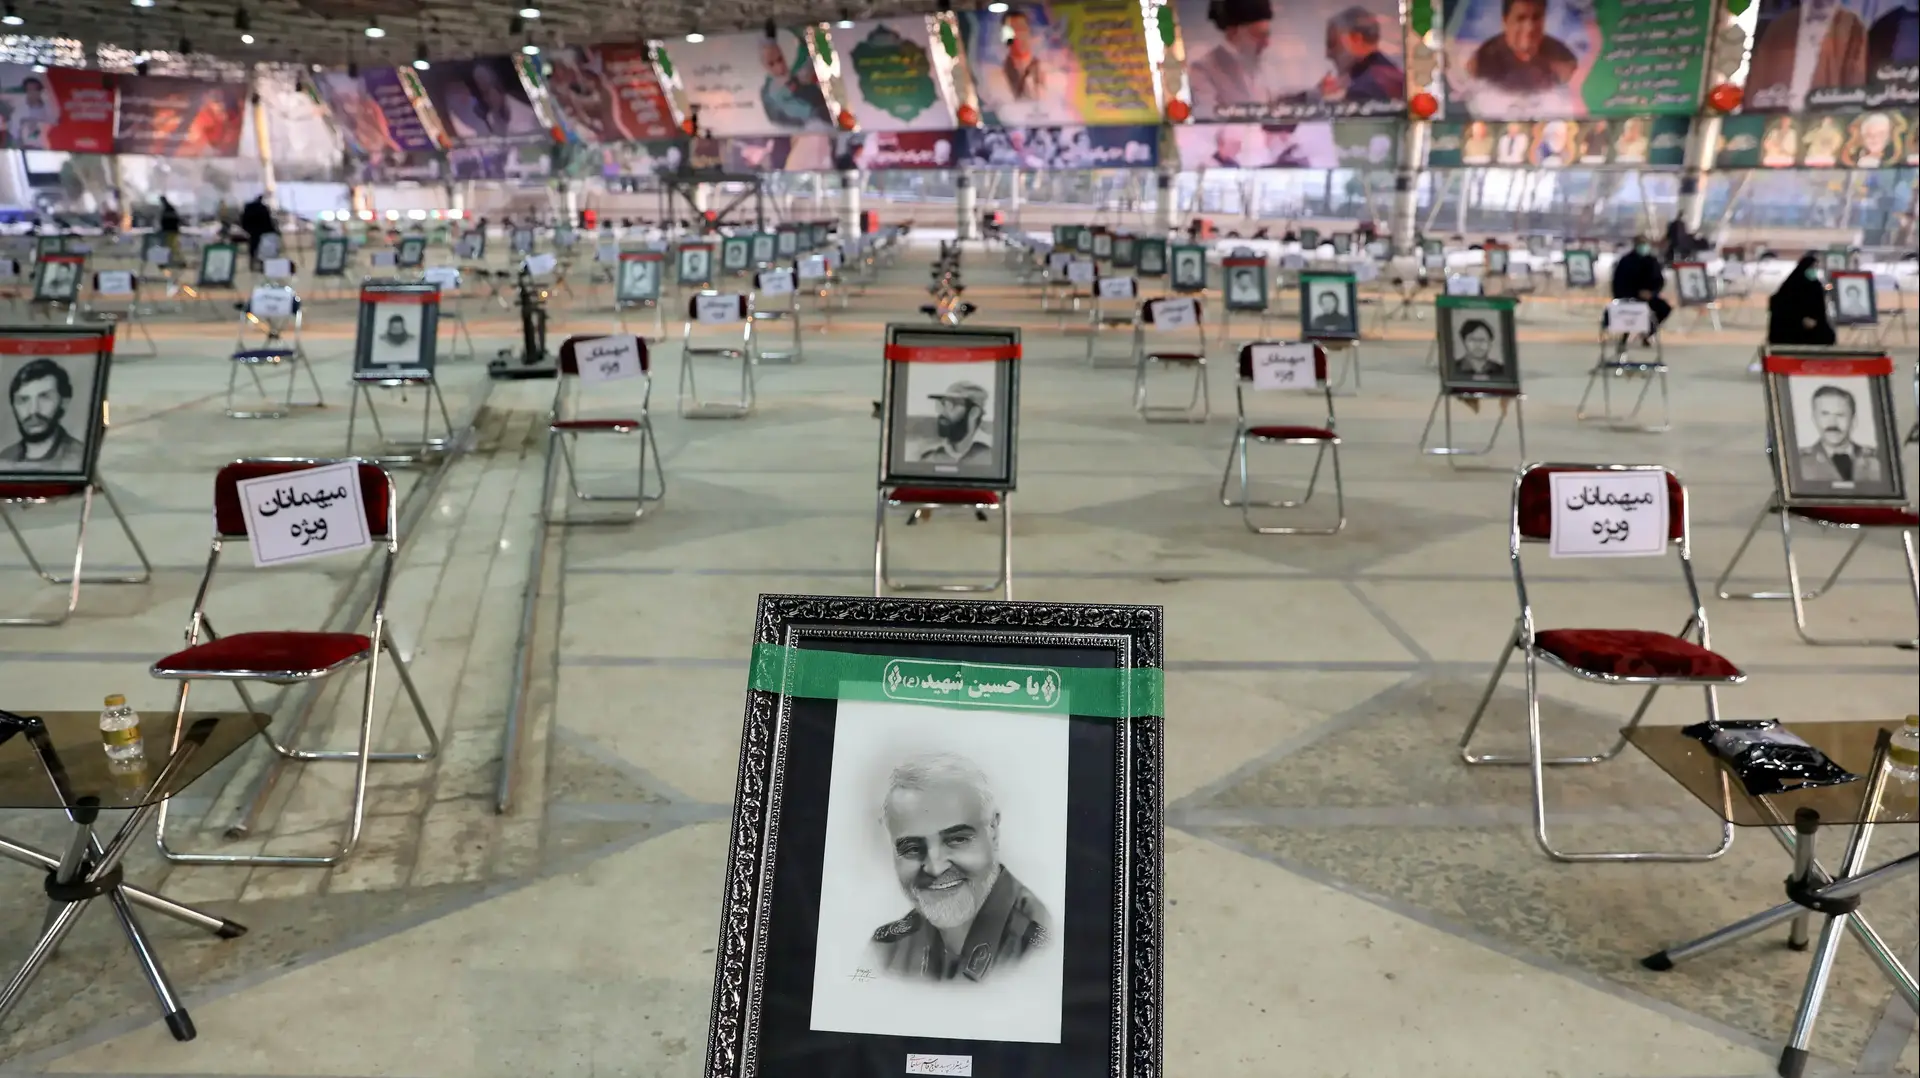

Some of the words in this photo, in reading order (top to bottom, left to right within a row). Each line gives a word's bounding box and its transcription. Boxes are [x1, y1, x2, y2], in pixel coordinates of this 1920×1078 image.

[258, 485, 347, 516] میهمانان
[1566, 486, 1653, 511] میهمانان
[290, 517, 328, 545] ویژه
[1592, 518, 1629, 543] ویژه
[921, 671, 964, 694] شهید
[968, 679, 1021, 698] حسین
[1026, 675, 1040, 700] یا
